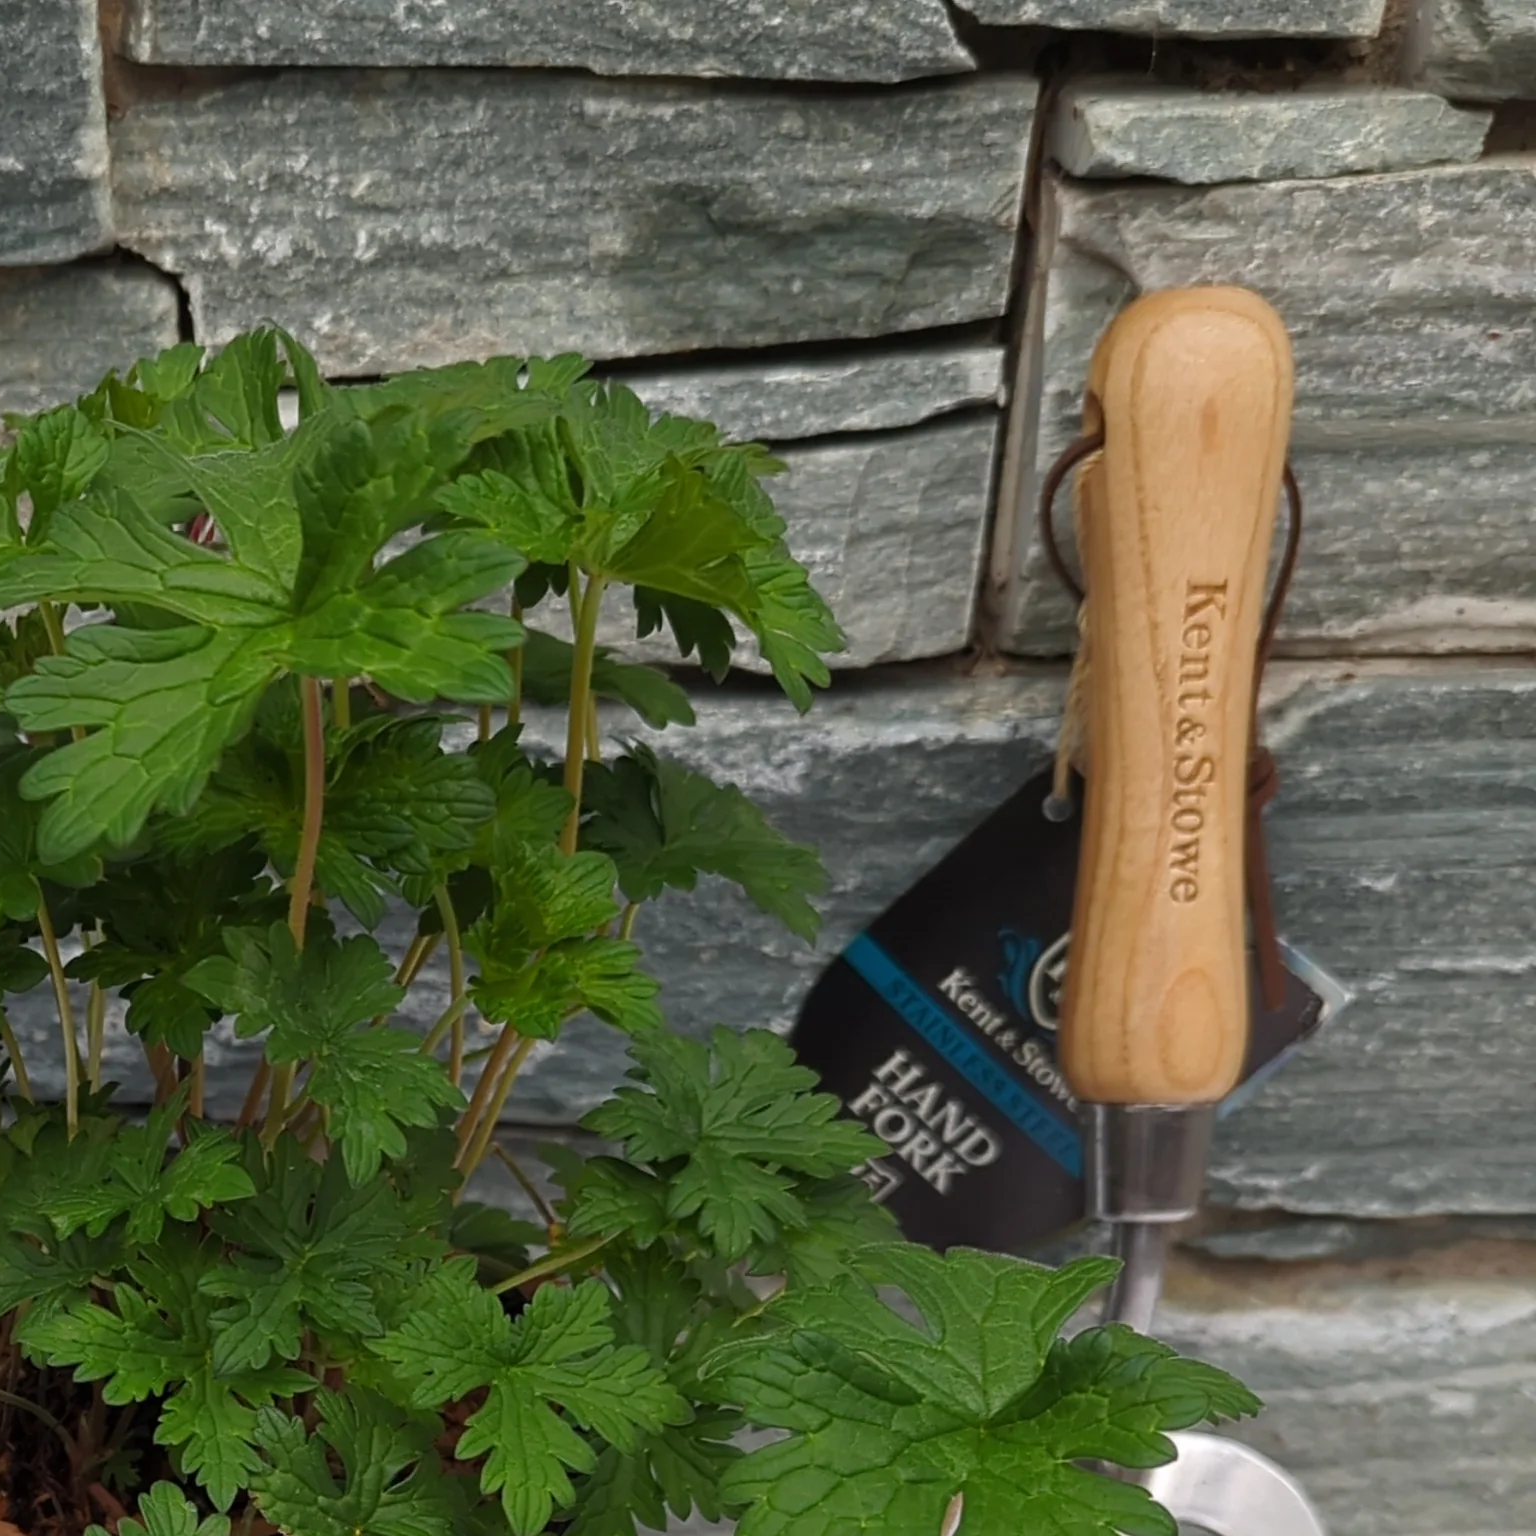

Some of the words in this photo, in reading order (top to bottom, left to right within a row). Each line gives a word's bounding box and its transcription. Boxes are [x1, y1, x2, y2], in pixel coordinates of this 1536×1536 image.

[1177, 578, 1228, 707] Kent
[1174, 716, 1206, 746] &
[1168, 753, 1215, 904] Stowe
[889, 978, 1007, 1095] STAINLESS
[936, 966, 1008, 1035] Kent
[994, 1029, 1017, 1050] &
[847, 1082, 967, 1195] FORK
[872, 1048, 1000, 1167] HAND
